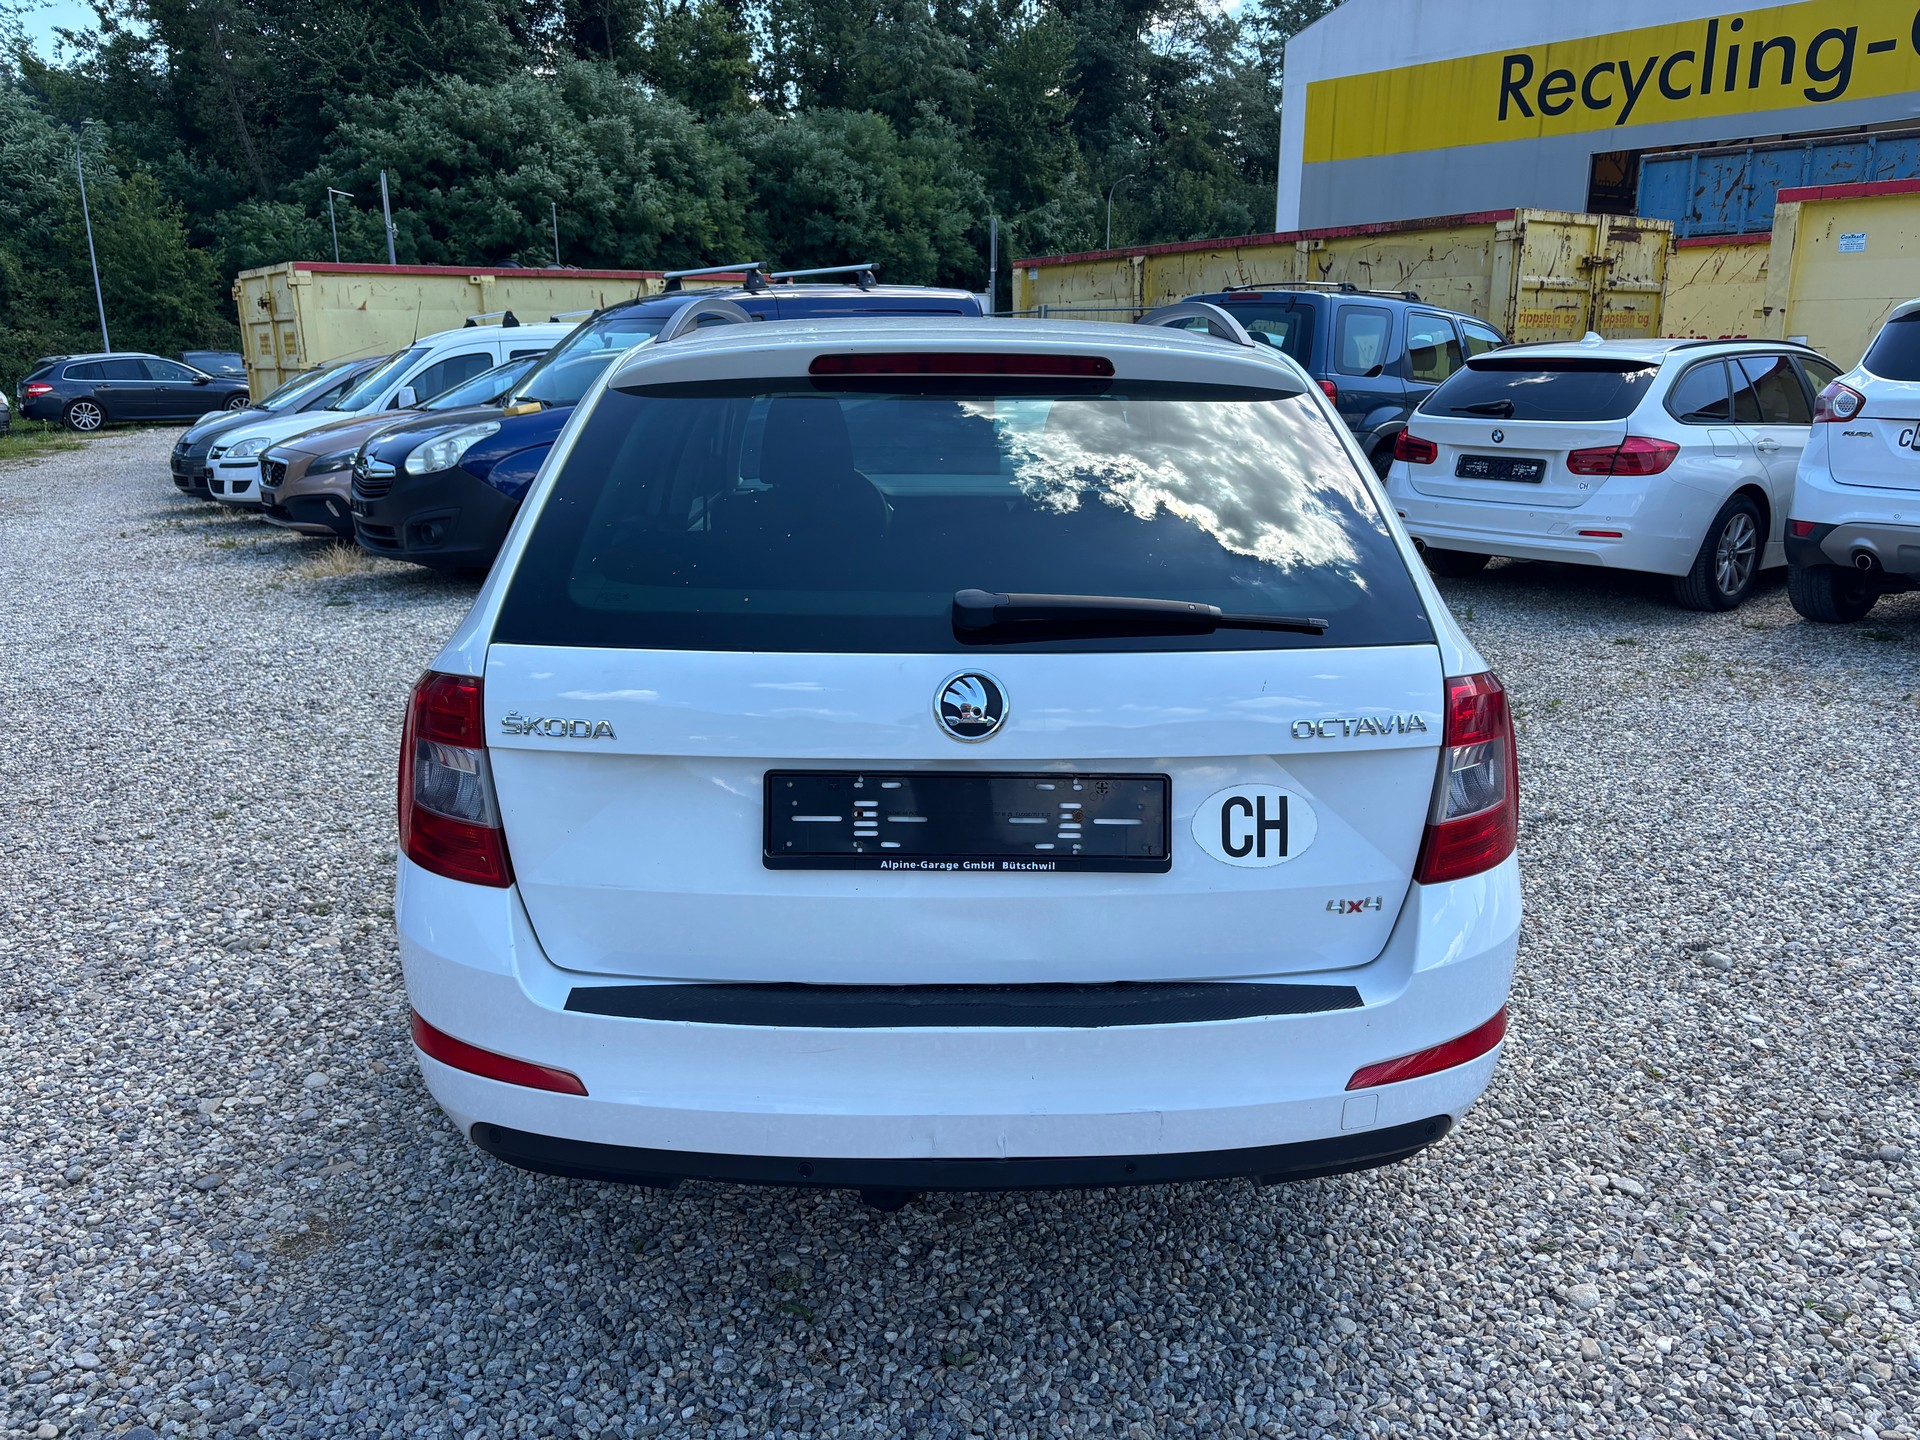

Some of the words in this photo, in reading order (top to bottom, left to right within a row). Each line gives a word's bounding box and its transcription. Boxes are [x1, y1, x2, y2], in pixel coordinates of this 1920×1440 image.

[1497, 8, 1920, 126] Recycling-
[1518, 310, 1561, 327] rippstein
[1637, 313, 1650, 328] ag
[1898, 428, 1914, 448] C
[1579, 482, 1589, 490] CH
[501, 709, 618, 741] ŠKODA
[1290, 713, 1428, 740] OCTAVIA
[1221, 795, 1289, 858] CH
[880, 860, 959, 871] Alpine-Garage
[962, 860, 995, 870] GmbH
[1002, 861, 1056, 871] Bütschwil
[1325, 895, 1384, 915] 4x4
